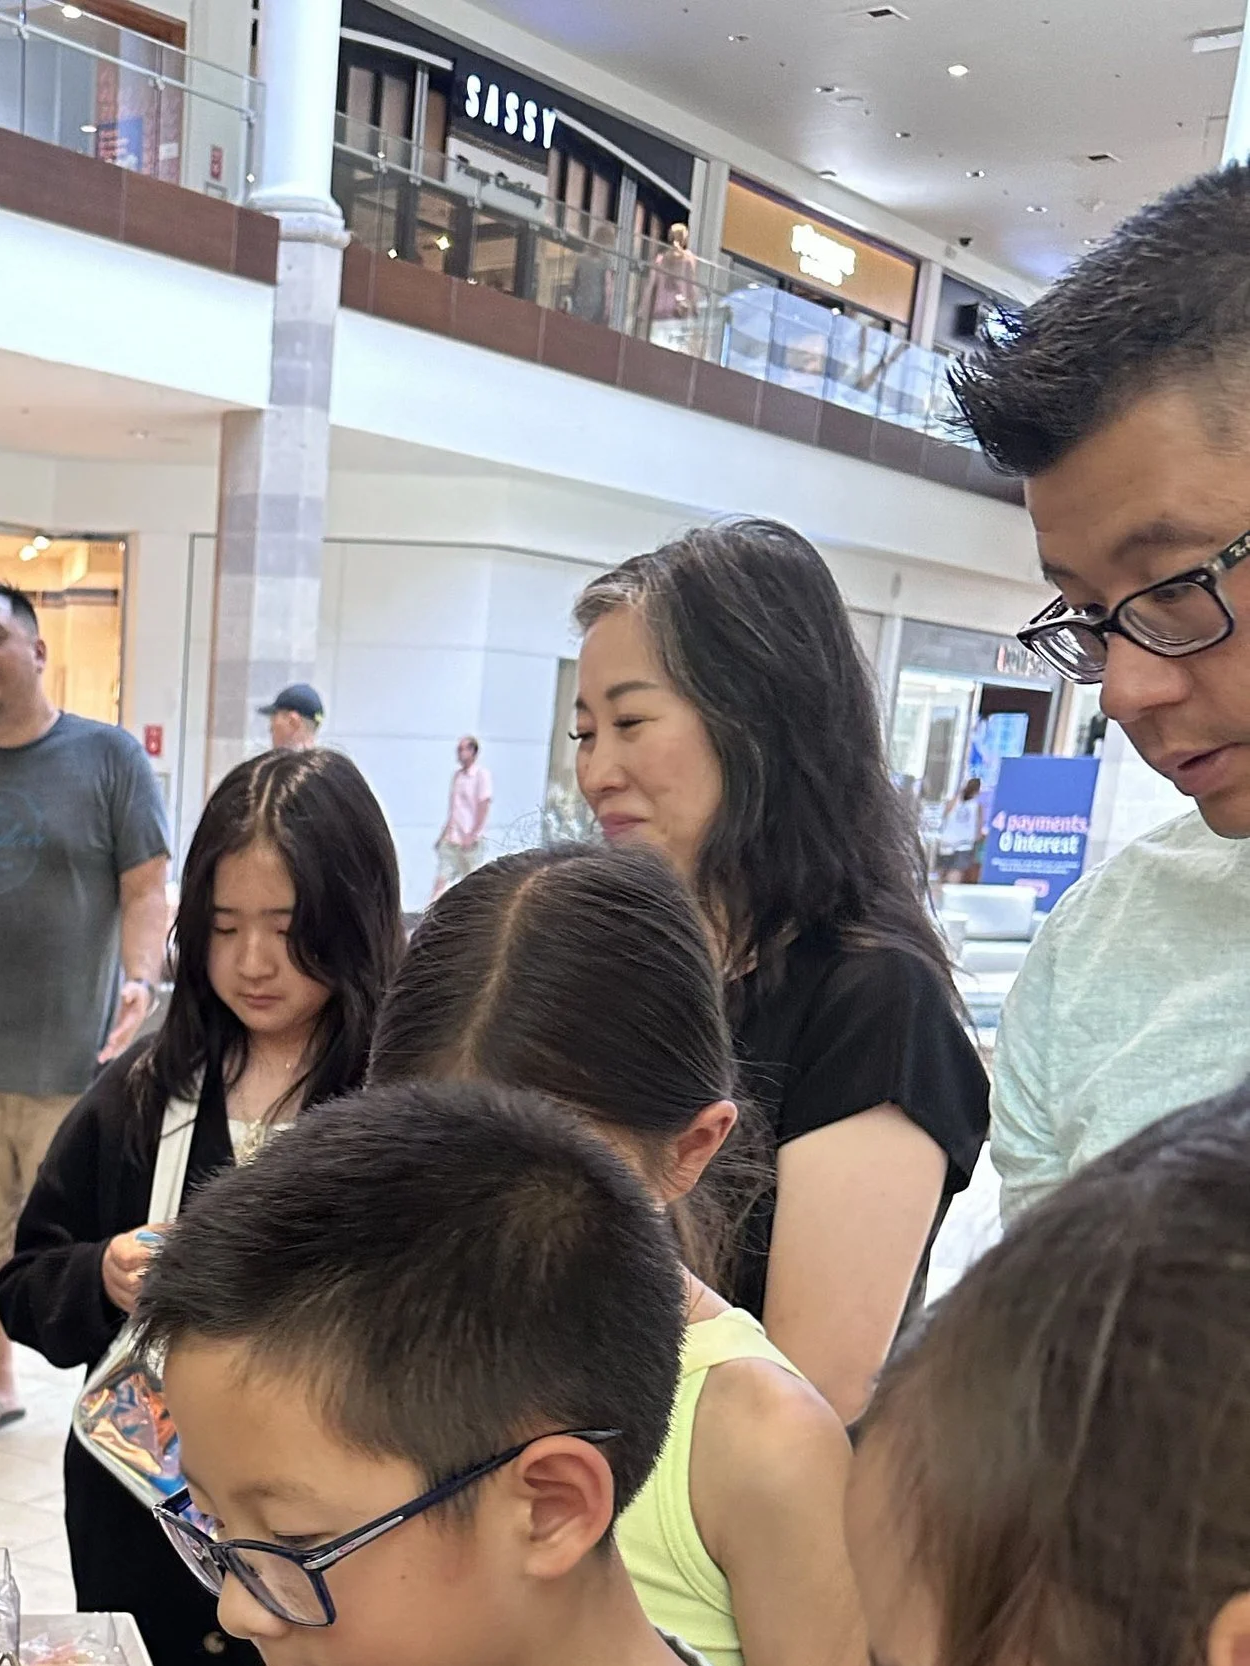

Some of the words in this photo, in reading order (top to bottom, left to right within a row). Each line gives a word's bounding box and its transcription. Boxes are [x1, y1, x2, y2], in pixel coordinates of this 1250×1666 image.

[465, 74, 557, 149] SASSY
[991, 810, 1007, 831] 4
[999, 831, 1013, 852] 0
[1013, 832, 1080, 856] interest
